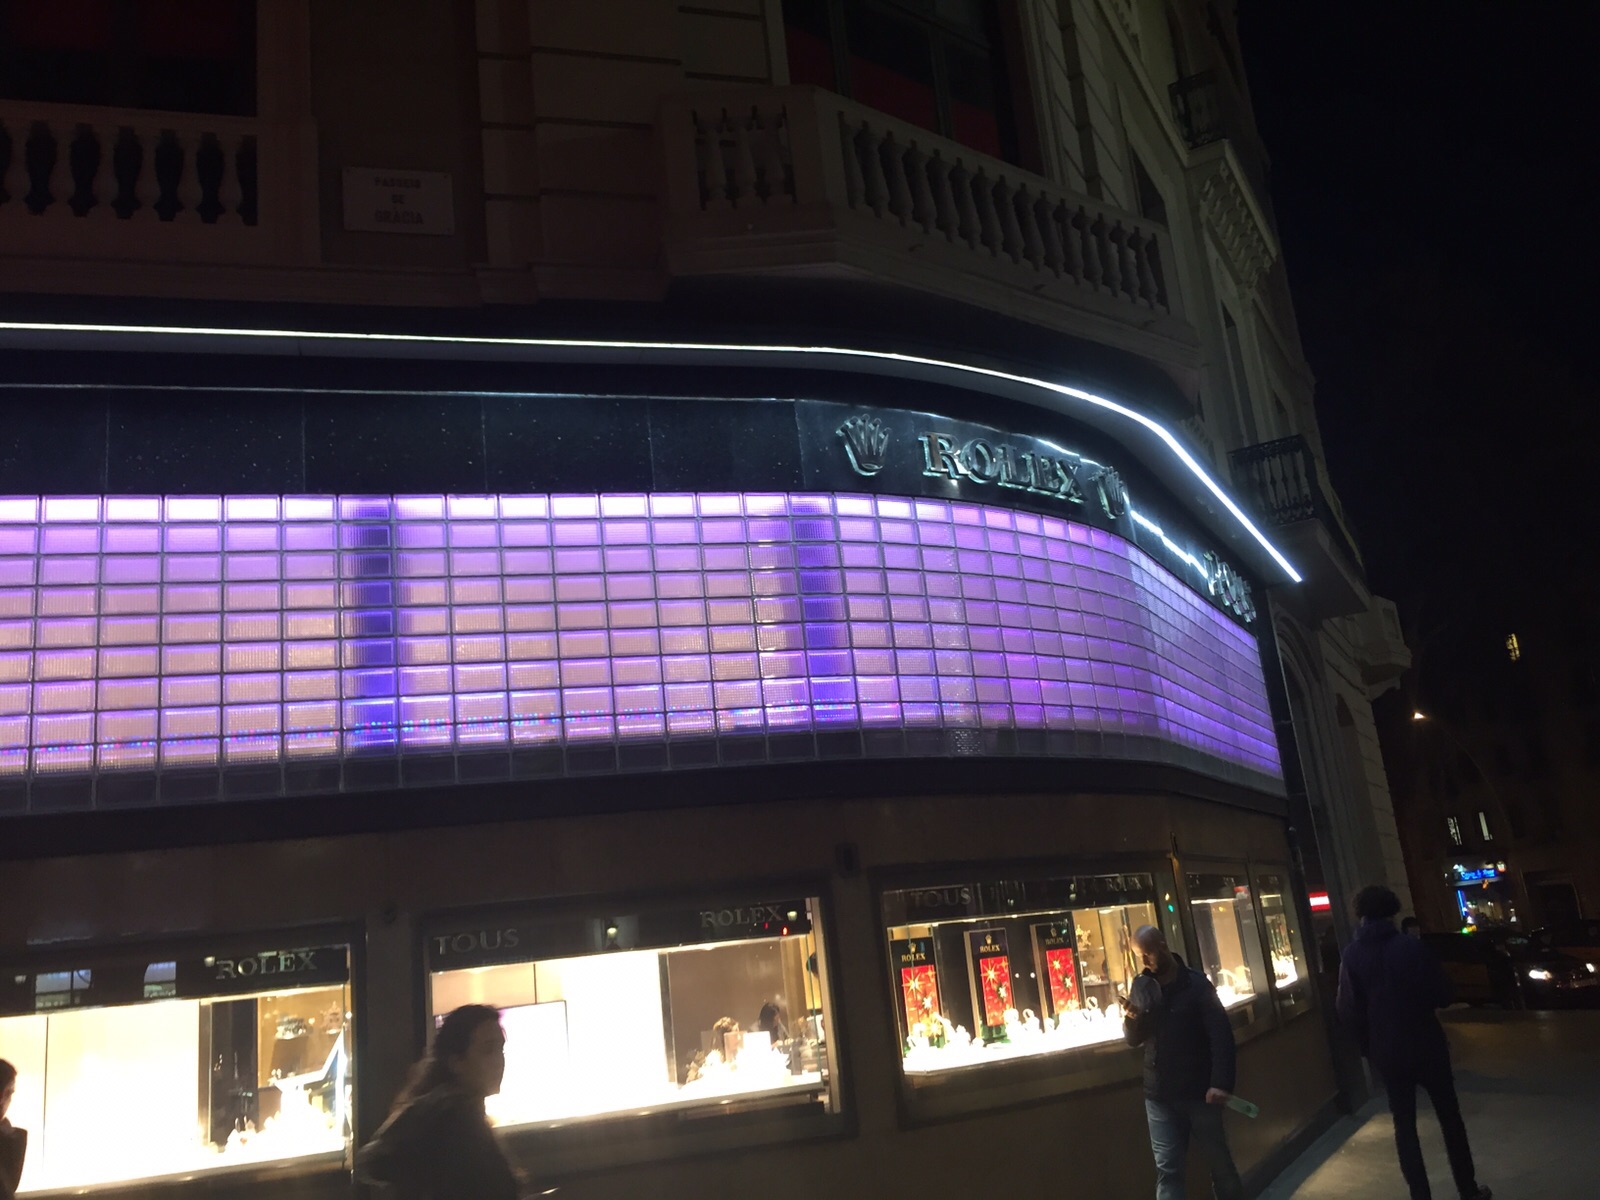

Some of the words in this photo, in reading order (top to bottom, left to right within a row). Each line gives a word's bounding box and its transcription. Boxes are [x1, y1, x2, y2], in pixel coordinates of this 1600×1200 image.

[916, 432, 1087, 505] ROLEX
[909, 887, 972, 908] TOUS
[699, 904, 784, 929] ROLEX
[433, 928, 519, 956] TOUS
[979, 944, 1001, 954] ROLEX
[215, 951, 317, 980] ROLEX
[901, 952, 926, 963] ROLEX
